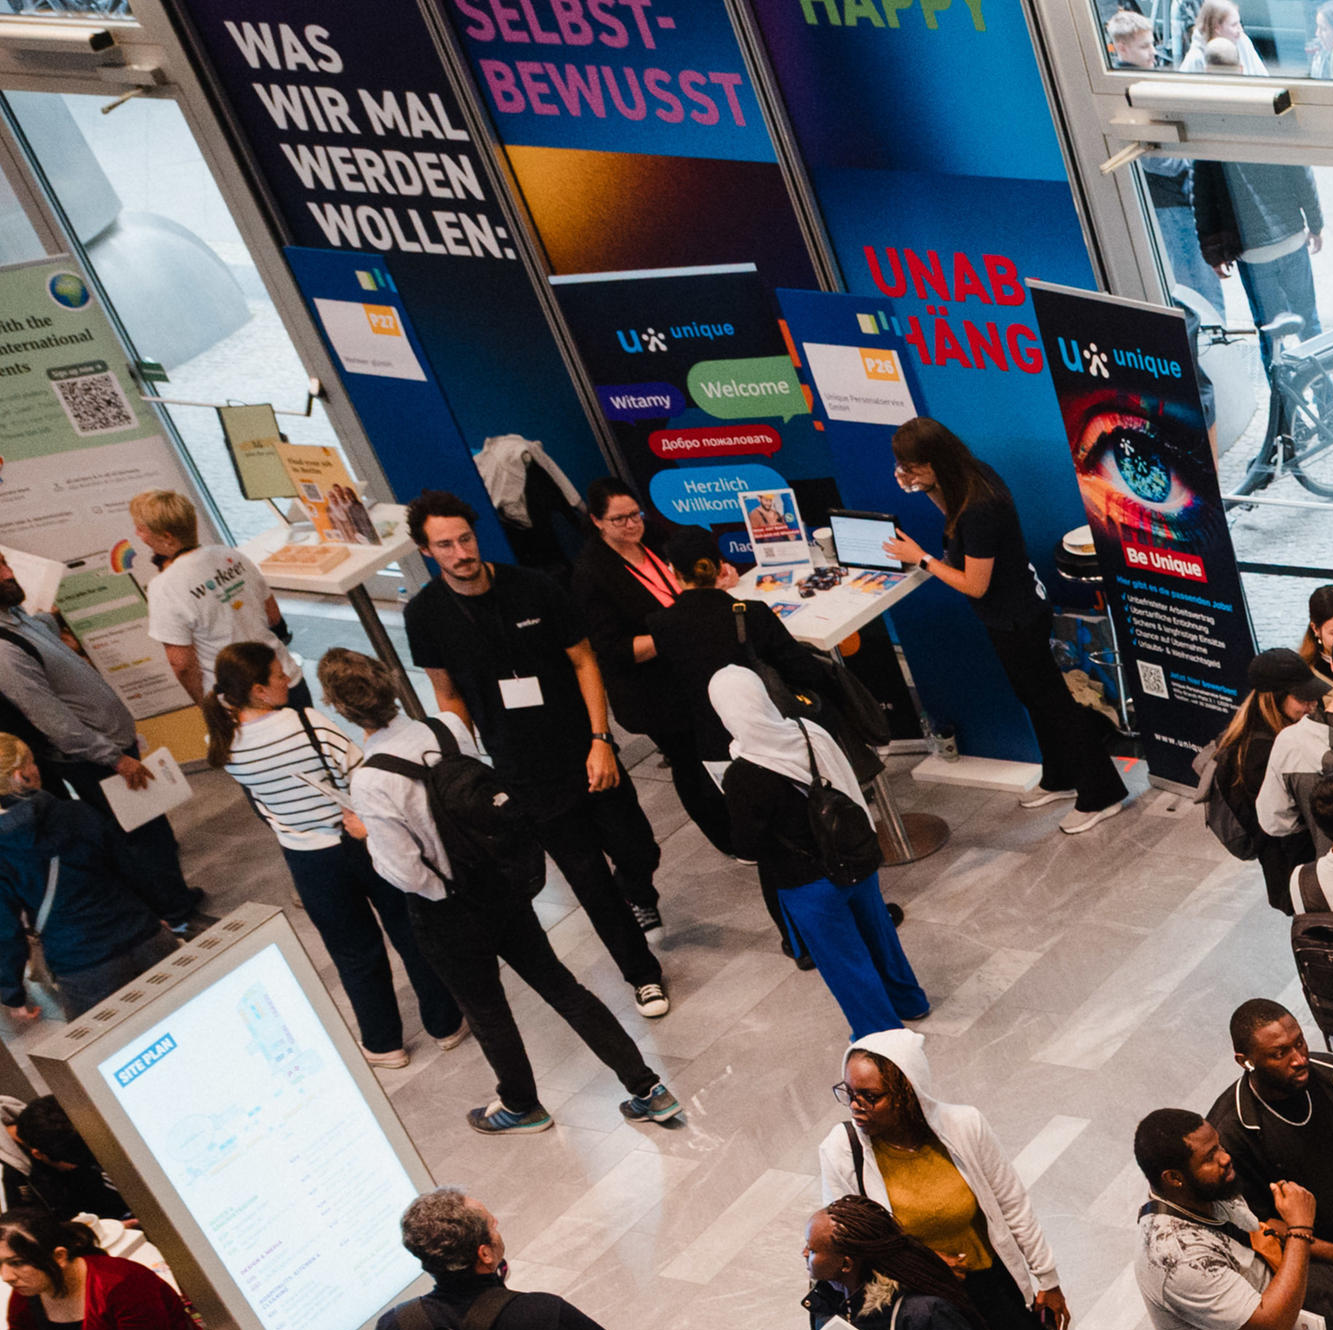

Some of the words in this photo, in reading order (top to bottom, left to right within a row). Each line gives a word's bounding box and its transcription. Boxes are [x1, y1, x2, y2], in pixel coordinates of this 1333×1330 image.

[464, 0, 677, 50] SELBST-
[224, 20, 344, 74] WAS
[479, 58, 747, 127] BEWUSST
[252, 83, 361, 134] WIR
[358, 88, 471, 141] MAL
[279, 143, 485, 200] WERDEN
[306, 202, 517, 260] WOLLEN:
[863, 245, 1027, 307] UNAB
[25, 315, 52, 329] the
[369, 313, 394, 329] P27
[670, 321, 735, 340] unique
[0, 328, 94, 356] nternational
[865, 359, 894, 374] P26
[1112, 347, 1182, 380] unique
[609, 392, 672, 411] Witamy
[699, 379, 790, 400] Welcome
[661, 436, 700, 452] Добро
[702, 434, 773, 448] пожаловать
[684, 477, 749, 493] Herzlich
[672, 497, 739, 514] Willkom
[1126, 547, 1148, 565] Be
[1150, 552, 1202, 577] Unique
